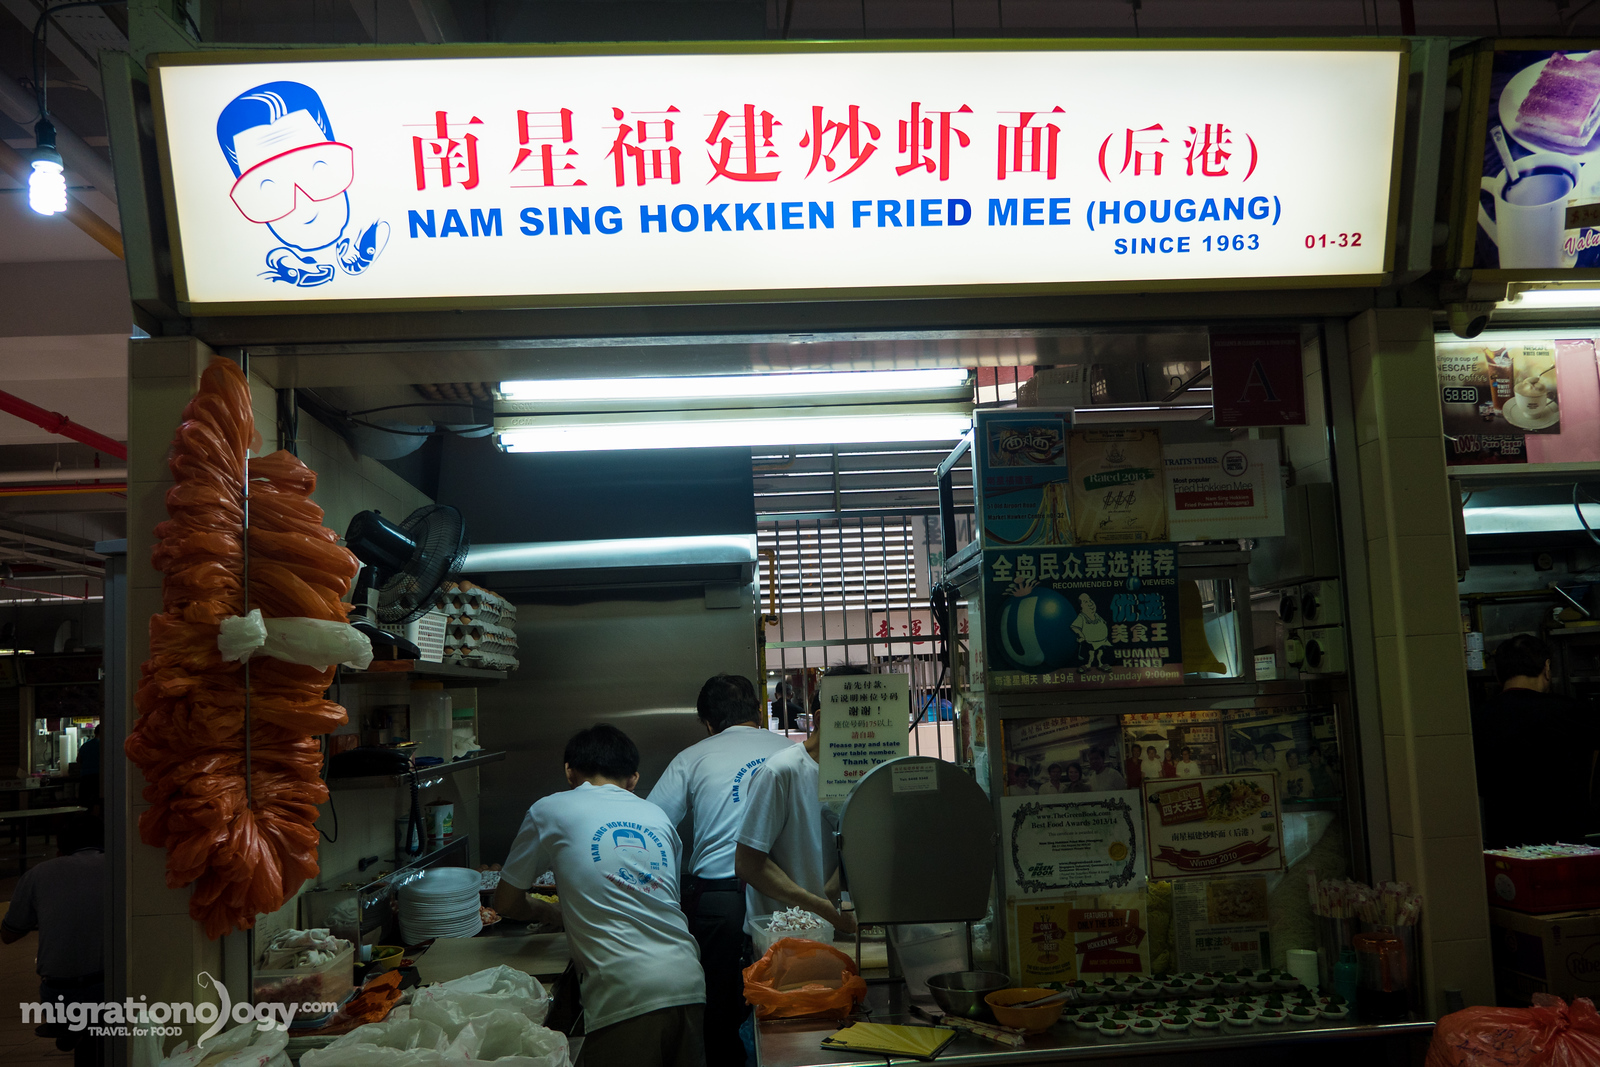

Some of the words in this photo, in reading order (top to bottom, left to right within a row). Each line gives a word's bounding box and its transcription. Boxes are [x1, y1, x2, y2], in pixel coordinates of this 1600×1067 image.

[402, 101, 1067, 191] 南星福建炒虾面
[1098, 123, 1258, 183] (后港)
[408, 208, 502, 238] NAM
[519, 205, 623, 236] SING
[640, 201, 834, 234] HOKKIEN
[852, 198, 972, 228] FRIED
[988, 198, 1072, 226] MEE
[1086, 195, 1282, 231] (HOUGANG)
[1114, 236, 1191, 255] SINCE
[1201, 233, 1260, 252] 1963
[1305, 232, 1362, 250] 01-32
[1236, 358, 1282, 402] A
[1458, 374, 1487, 382] Coffee
[1445, 389, 1475, 402] $8.88
[1452, 434, 1480, 454] 100%
[1089, 473, 1120, 482] Rated
[1121, 473, 1146, 481] 2013
[1174, 484, 1194, 493] Fried
[1196, 482, 1232, 492] Hokkien
[1234, 482, 1253, 490] Mee
[991, 548, 1175, 582] 全岛民众票选推荐
[1052, 581, 1112, 590] RECOMMENDED
[1111, 622, 1168, 643] 美食王
[1080, 673, 1106, 684] Every
[1108, 671, 1142, 682] Sunday
[1145, 670, 1180, 680] 9:00pm
[734, 767, 747, 783] SING
[732, 785, 740, 803] NAM
[1037, 811, 1110, 819] www.TheGreenBook.com
[1162, 798, 1203, 816] 四大天王
[593, 826, 608, 842] SING
[606, 821, 642, 831] HOKKIEN
[643, 828, 663, 848] FRIED
[591, 844, 602, 863] NAM
[660, 850, 668, 868] MEE
[1189, 856, 1218, 868] Winner
[1220, 852, 1238, 862] 2010
[1078, 921, 1093, 930] ONLY
[1095, 920, 1106, 928] THE
[1108, 918, 1123, 927] BEST
[1088, 938, 1108, 950] HOKKIEN
[1109, 936, 1119, 944] MEE
[1572, 958, 1600, 974] Ribe
